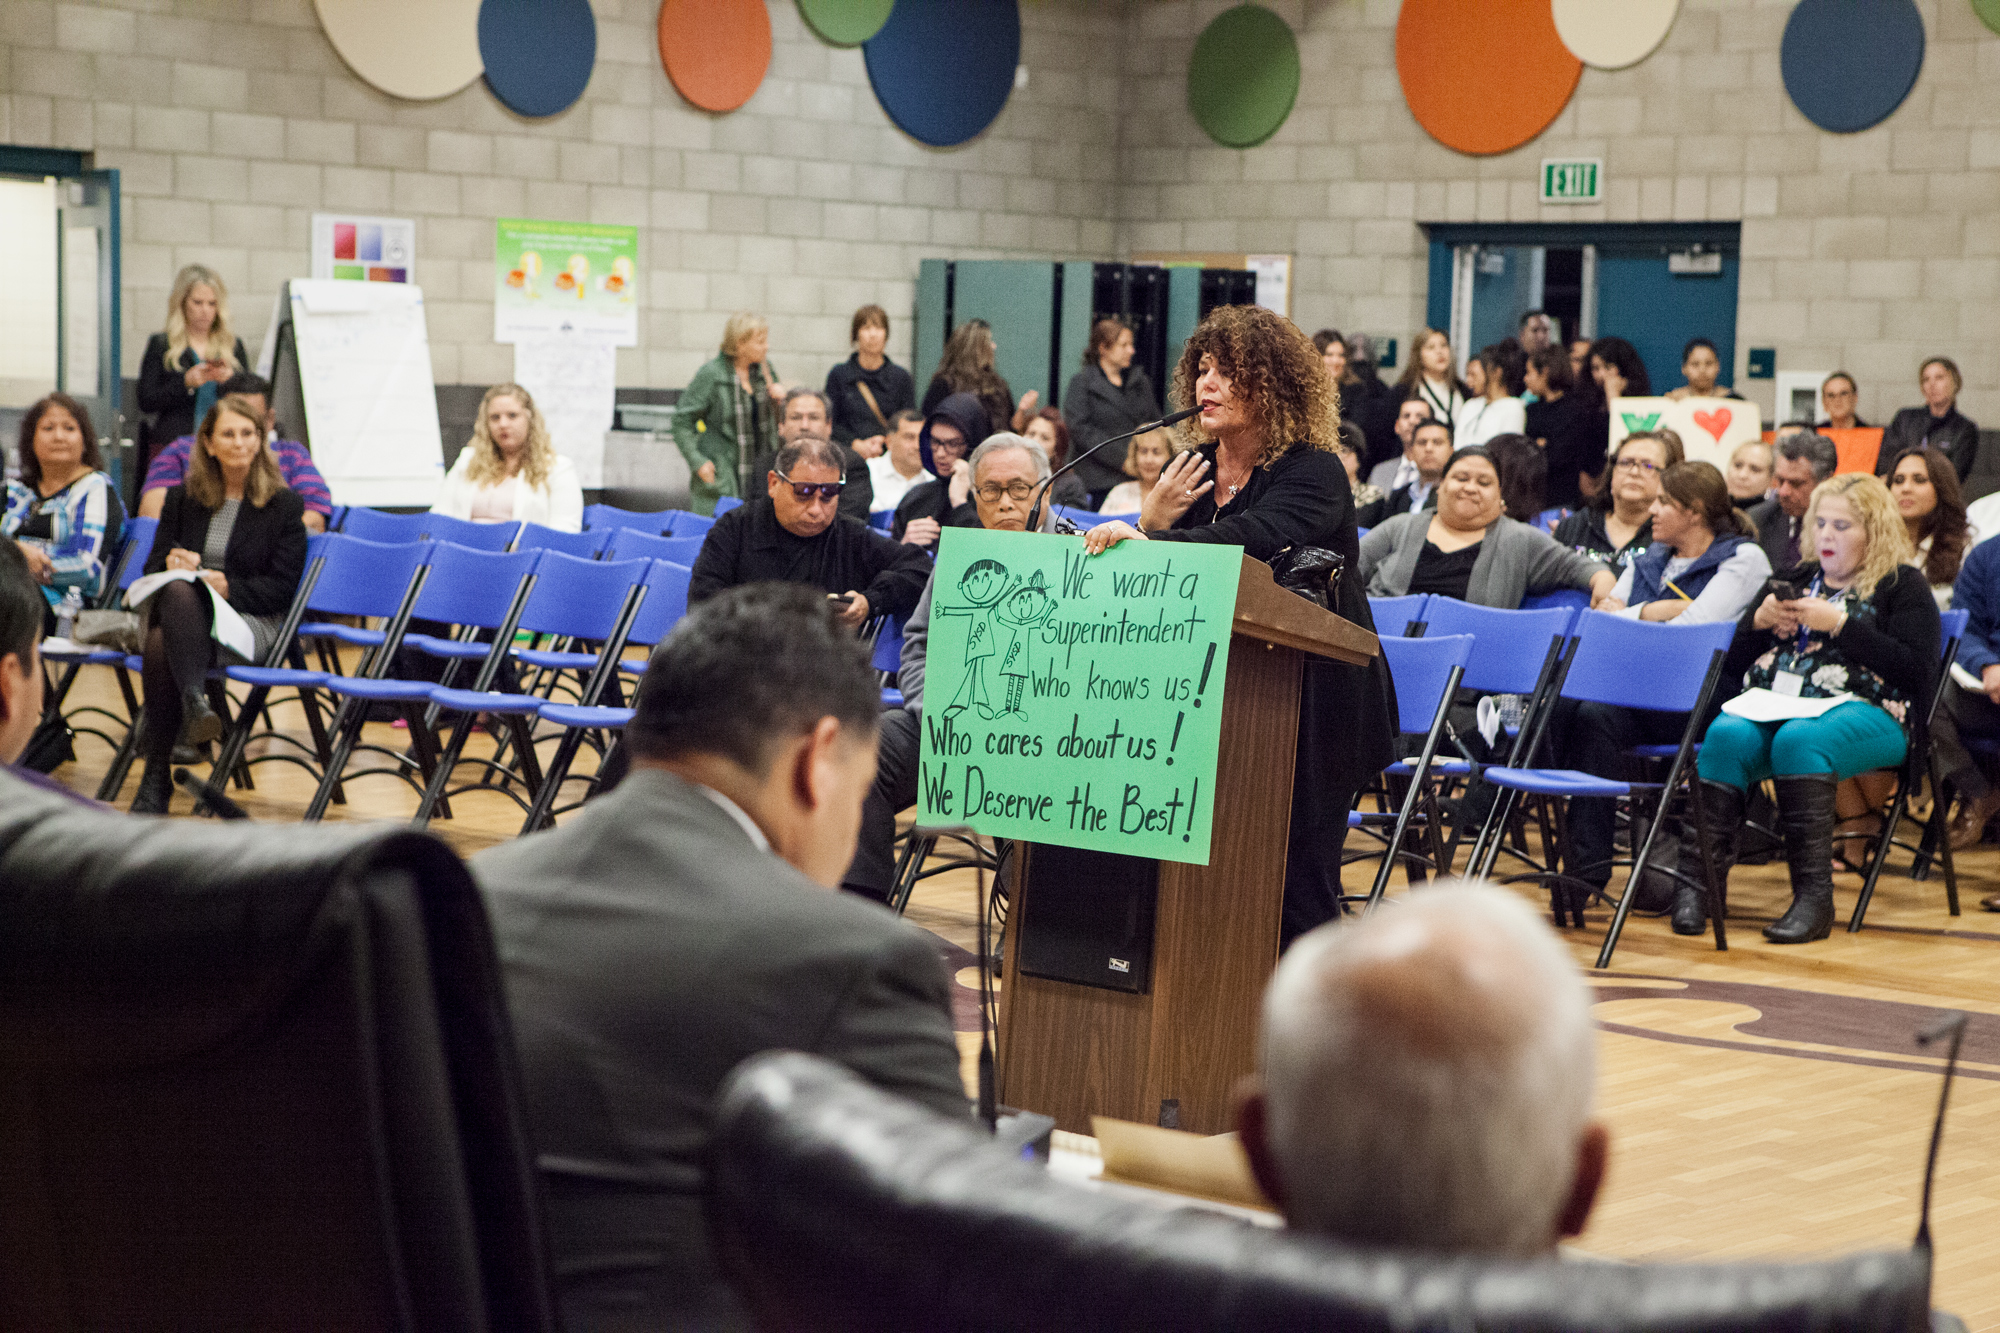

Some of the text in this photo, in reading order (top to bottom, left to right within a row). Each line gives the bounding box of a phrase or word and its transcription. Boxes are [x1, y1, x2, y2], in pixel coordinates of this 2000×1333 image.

[1551, 164, 1591, 197] EXIT
[1063, 547, 1198, 600] We want a
[967, 621, 987, 650] SYSD
[1006, 641, 1022, 668] SYSD
[1086, 660, 1149, 700] knows
[928, 714, 972, 756] Who
[985, 732, 1042, 757] cares
[1057, 713, 1124, 759] about
[923, 762, 1198, 843] We Deserve the Best!
